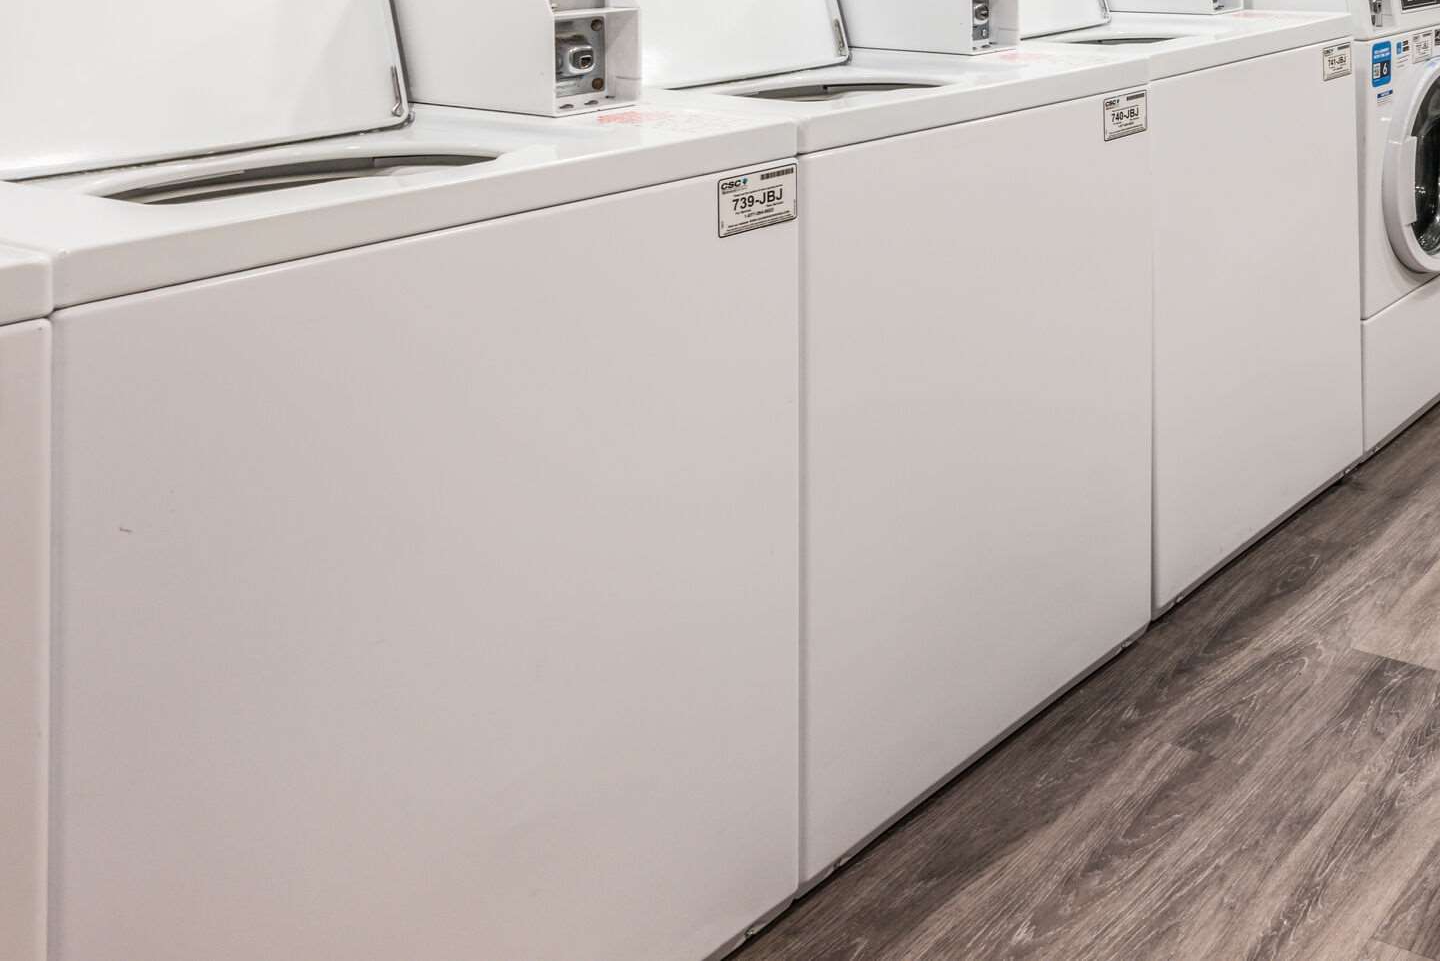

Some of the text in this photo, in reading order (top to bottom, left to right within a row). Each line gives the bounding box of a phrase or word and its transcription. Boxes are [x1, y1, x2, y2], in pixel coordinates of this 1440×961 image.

[1382, 62, 1388, 75] 6
[1111, 107, 1139, 122] 740-JBJ
[721, 179, 742, 190] CSC
[732, 188, 783, 211] 739-JBJ
